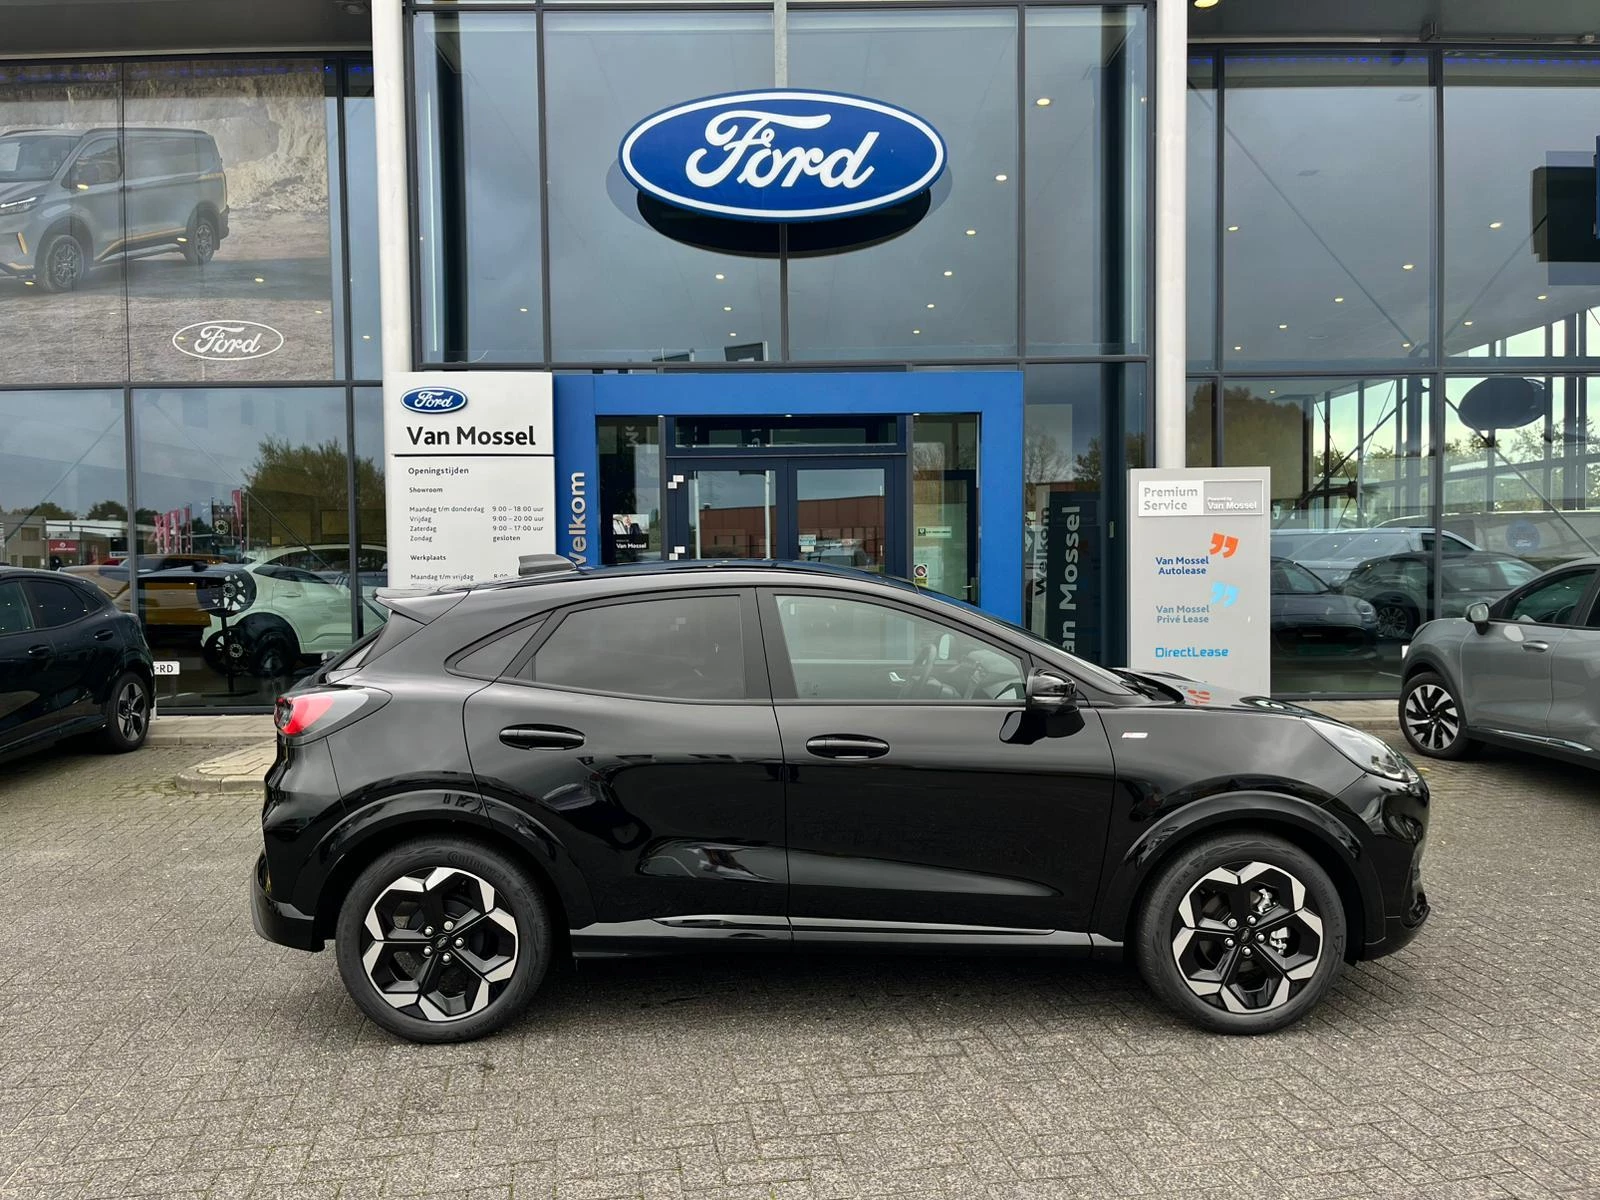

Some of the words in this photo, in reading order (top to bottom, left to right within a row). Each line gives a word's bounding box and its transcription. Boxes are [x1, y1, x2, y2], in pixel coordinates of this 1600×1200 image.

[685, 110, 880, 188] Ford
[194, 326, 262, 353] Ford
[414, 390, 454, 407] Ford
[406, 426, 450, 445] Van
[456, 425, 536, 446] Mossel
[408, 467, 469, 476] Openingstijden
[1144, 487, 1198, 497] Premium
[409, 505, 437, 514] Maandag
[451, 504, 485, 514] donderdag
[1144, 500, 1188, 511] Service
[1207, 501, 1224, 510] Van
[1226, 501, 1257, 510] Mossel
[409, 515, 432, 524] Vrijdag
[410, 525, 437, 533] Zaterdag
[492, 534, 521, 543] gesloten
[410, 554, 447, 562] Werkplaats
[1059, 506, 1081, 610] Mossel
[1155, 556, 1174, 565] Van
[1176, 555, 1209, 565] Mossel
[1158, 566, 1207, 575] Autolease
[410, 573, 438, 581] Maandag
[452, 573, 474, 582] vrijdag
[1155, 605, 1174, 613] Van
[1176, 604, 1210, 613] Mossel
[1156, 615, 1181, 623] Privé
[1183, 615, 1209, 623] Lease
[1155, 647, 1229, 658] DirectLease
